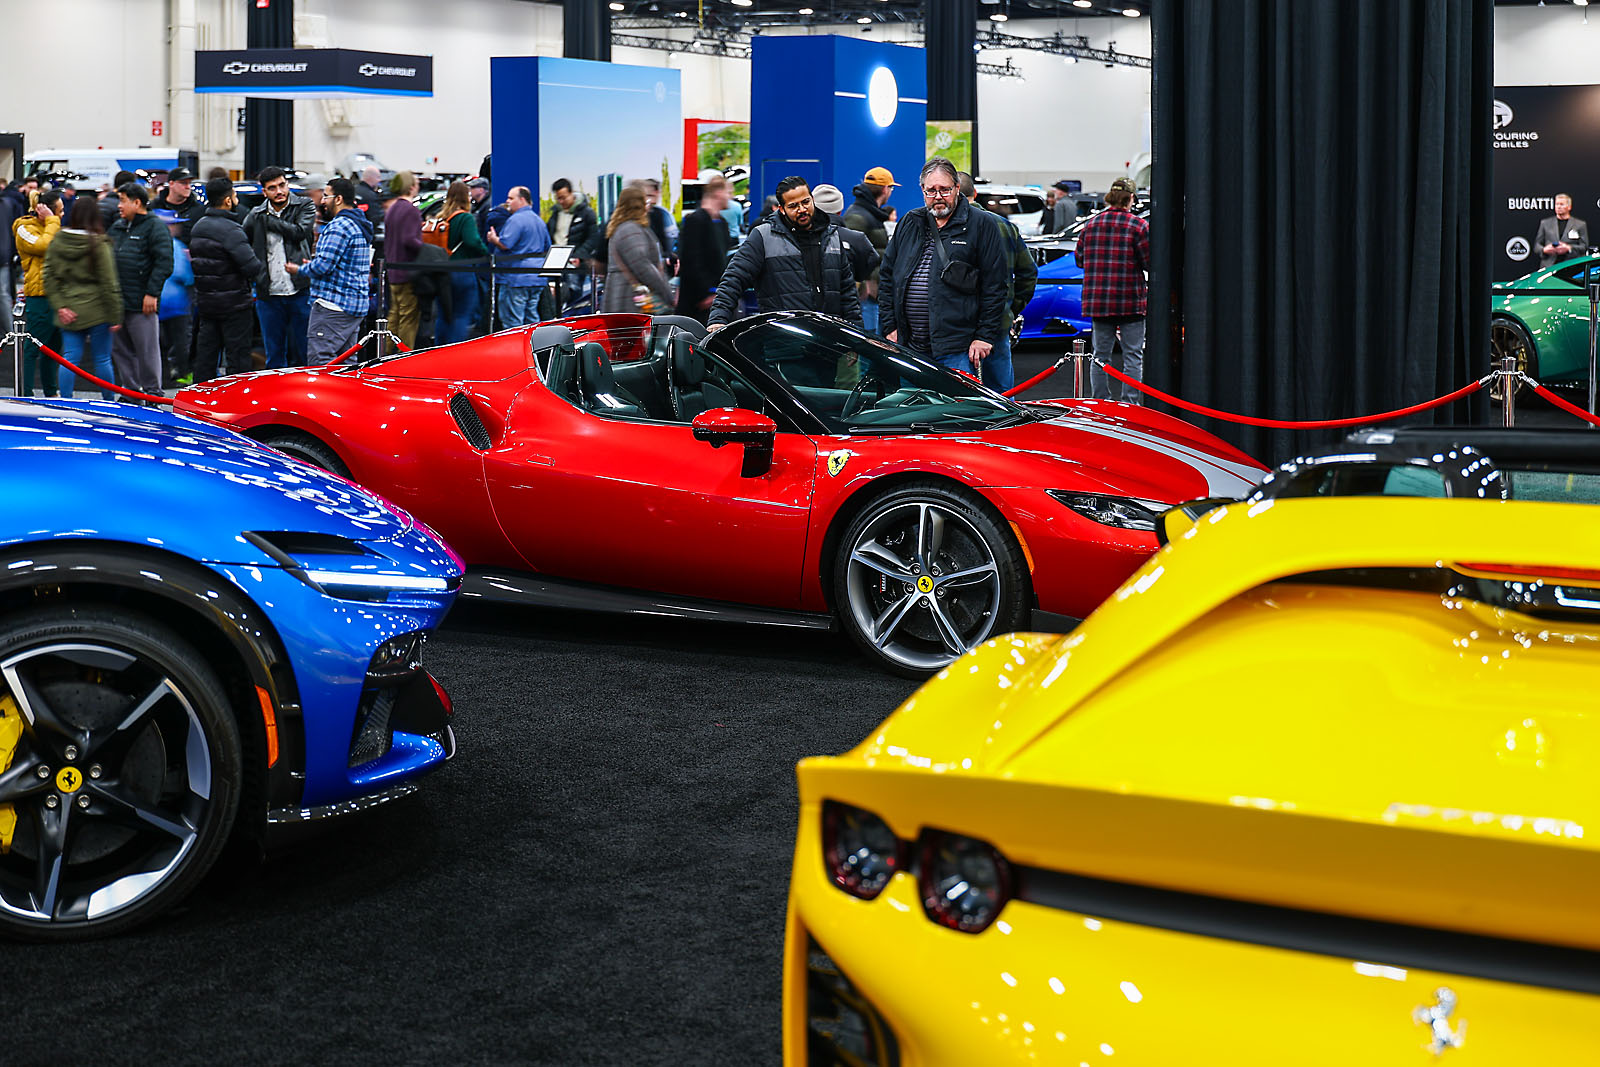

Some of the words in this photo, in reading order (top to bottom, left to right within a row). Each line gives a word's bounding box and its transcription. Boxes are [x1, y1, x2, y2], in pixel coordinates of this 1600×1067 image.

[250, 63, 308, 73] CHEVROLET
[377, 67, 417, 77] CHEVROLET
[1493, 131, 1539, 141] OURING
[1508, 197, 1554, 210] BUGATTI
